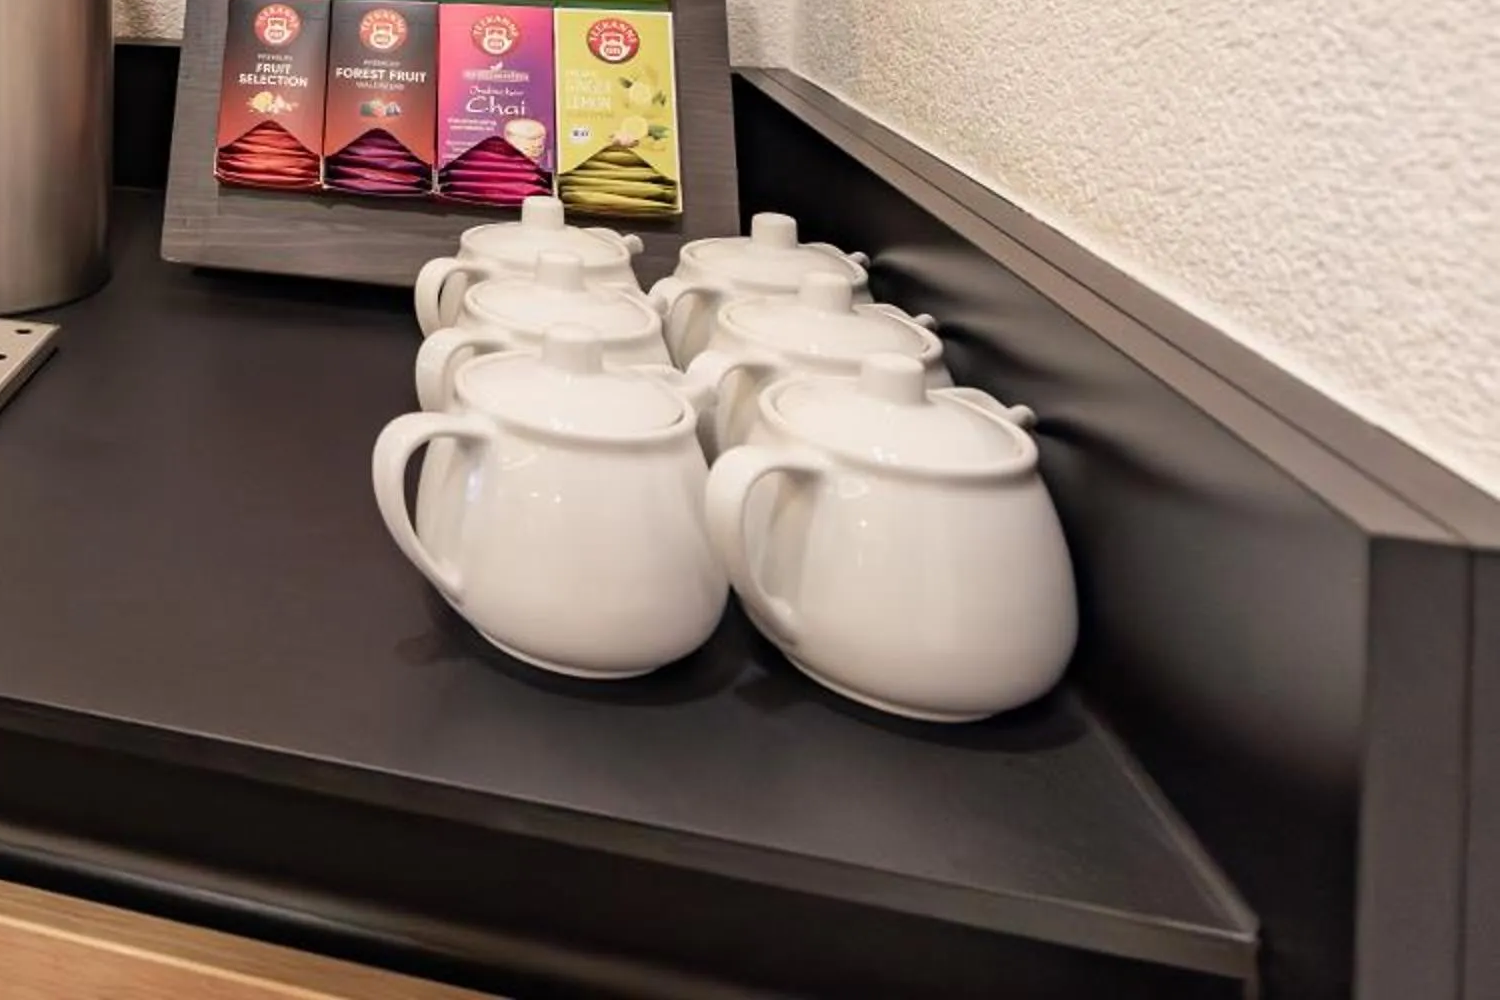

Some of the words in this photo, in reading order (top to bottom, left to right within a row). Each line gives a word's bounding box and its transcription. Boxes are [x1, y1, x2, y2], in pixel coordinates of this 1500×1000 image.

[255, 63, 291, 74] FRUIT
[335, 67, 386, 80] FOREST
[389, 70, 427, 83] FRUIT
[239, 73, 308, 88] SELECTION
[465, 95, 525, 116] Chai
